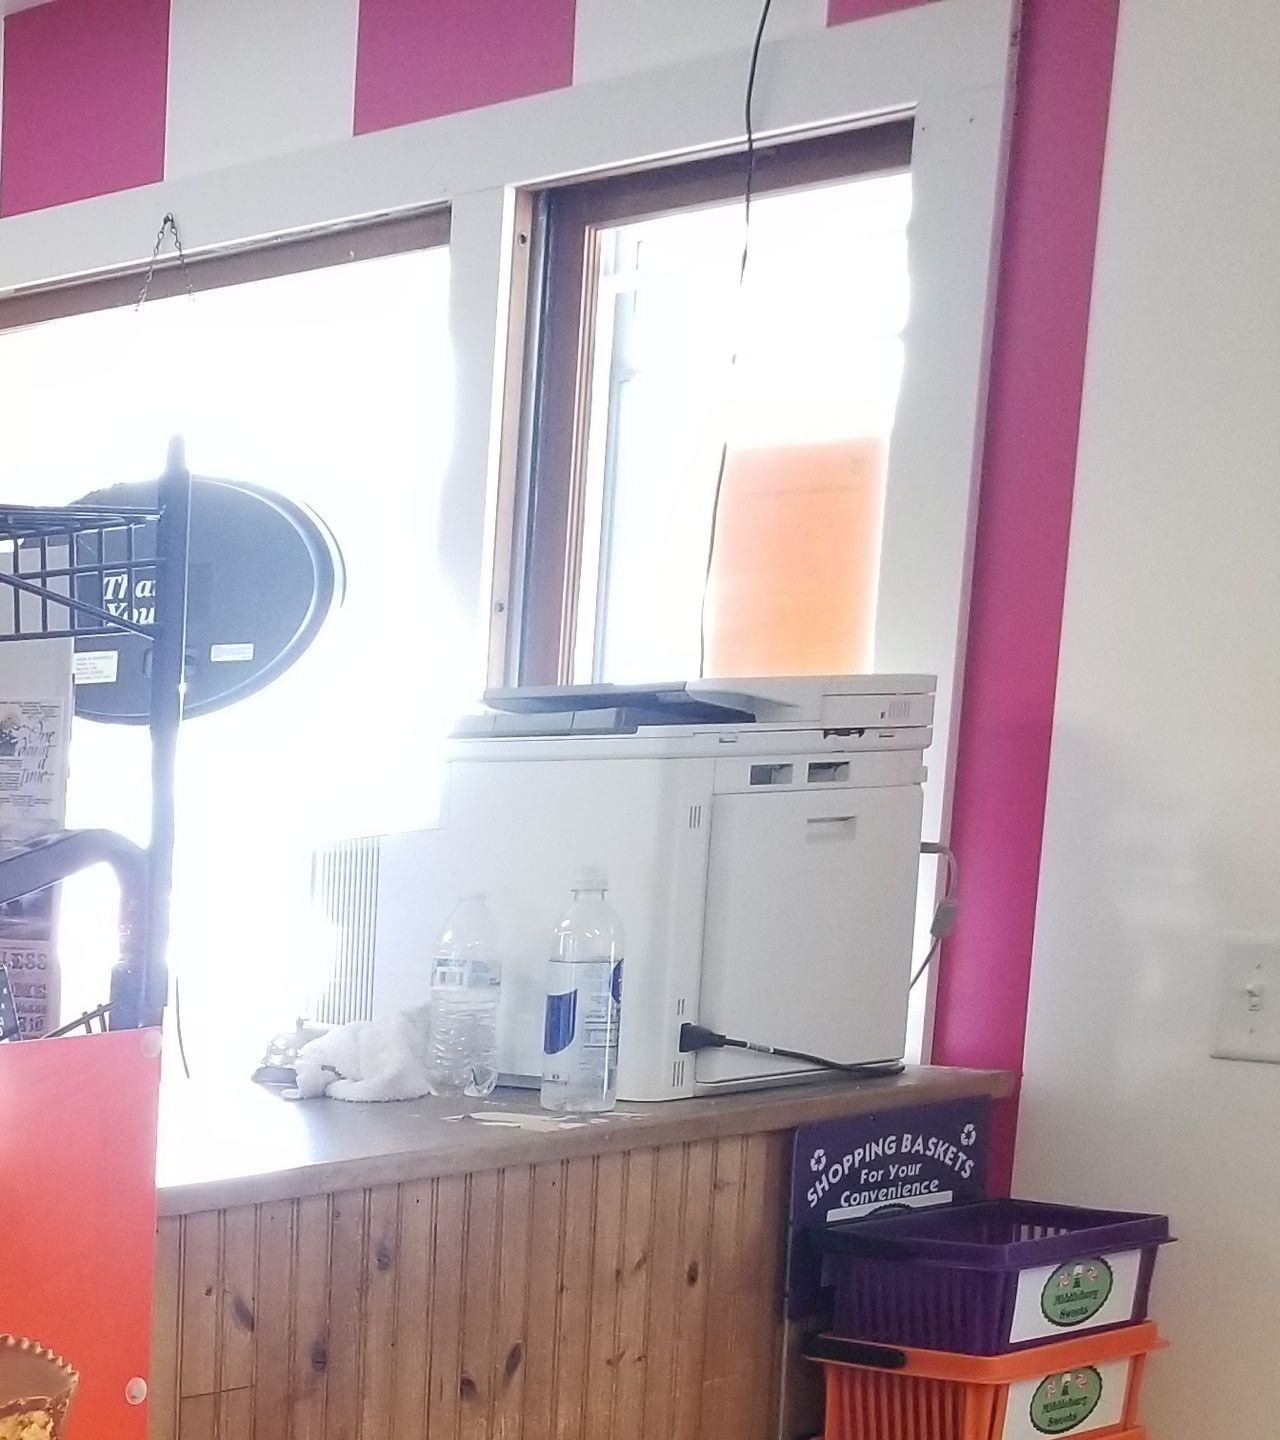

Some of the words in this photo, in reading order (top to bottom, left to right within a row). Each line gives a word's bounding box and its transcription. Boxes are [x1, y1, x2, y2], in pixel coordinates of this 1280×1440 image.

[806, 1133, 898, 1209] SHOPPING
[900, 1132, 975, 1181] BASKETS
[859, 1167, 884, 1186] For
[888, 1160, 923, 1181] Your
[838, 1178, 940, 1209] Convenience
